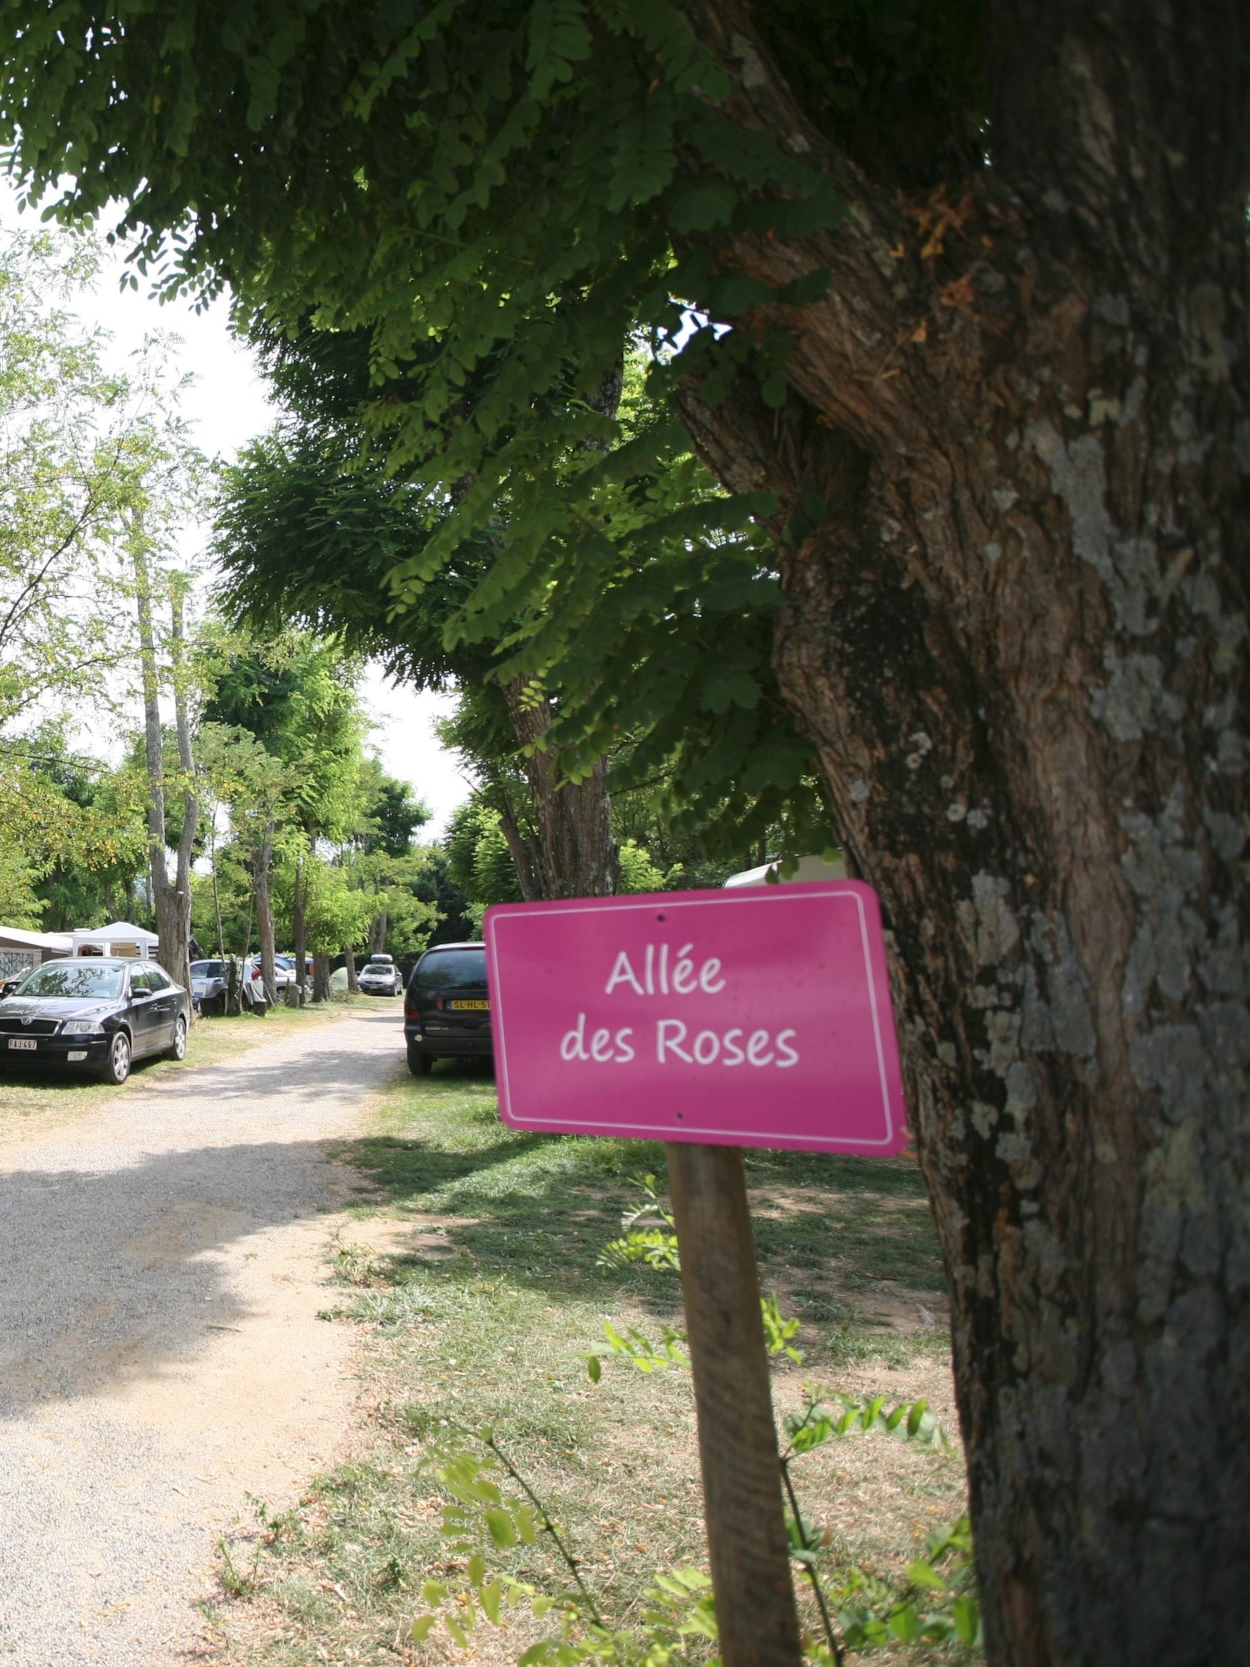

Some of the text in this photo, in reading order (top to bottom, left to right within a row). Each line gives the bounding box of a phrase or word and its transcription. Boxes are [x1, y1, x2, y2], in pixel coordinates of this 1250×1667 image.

[604, 943, 727, 996] Allée
[559, 1012, 800, 1068] des Roses
